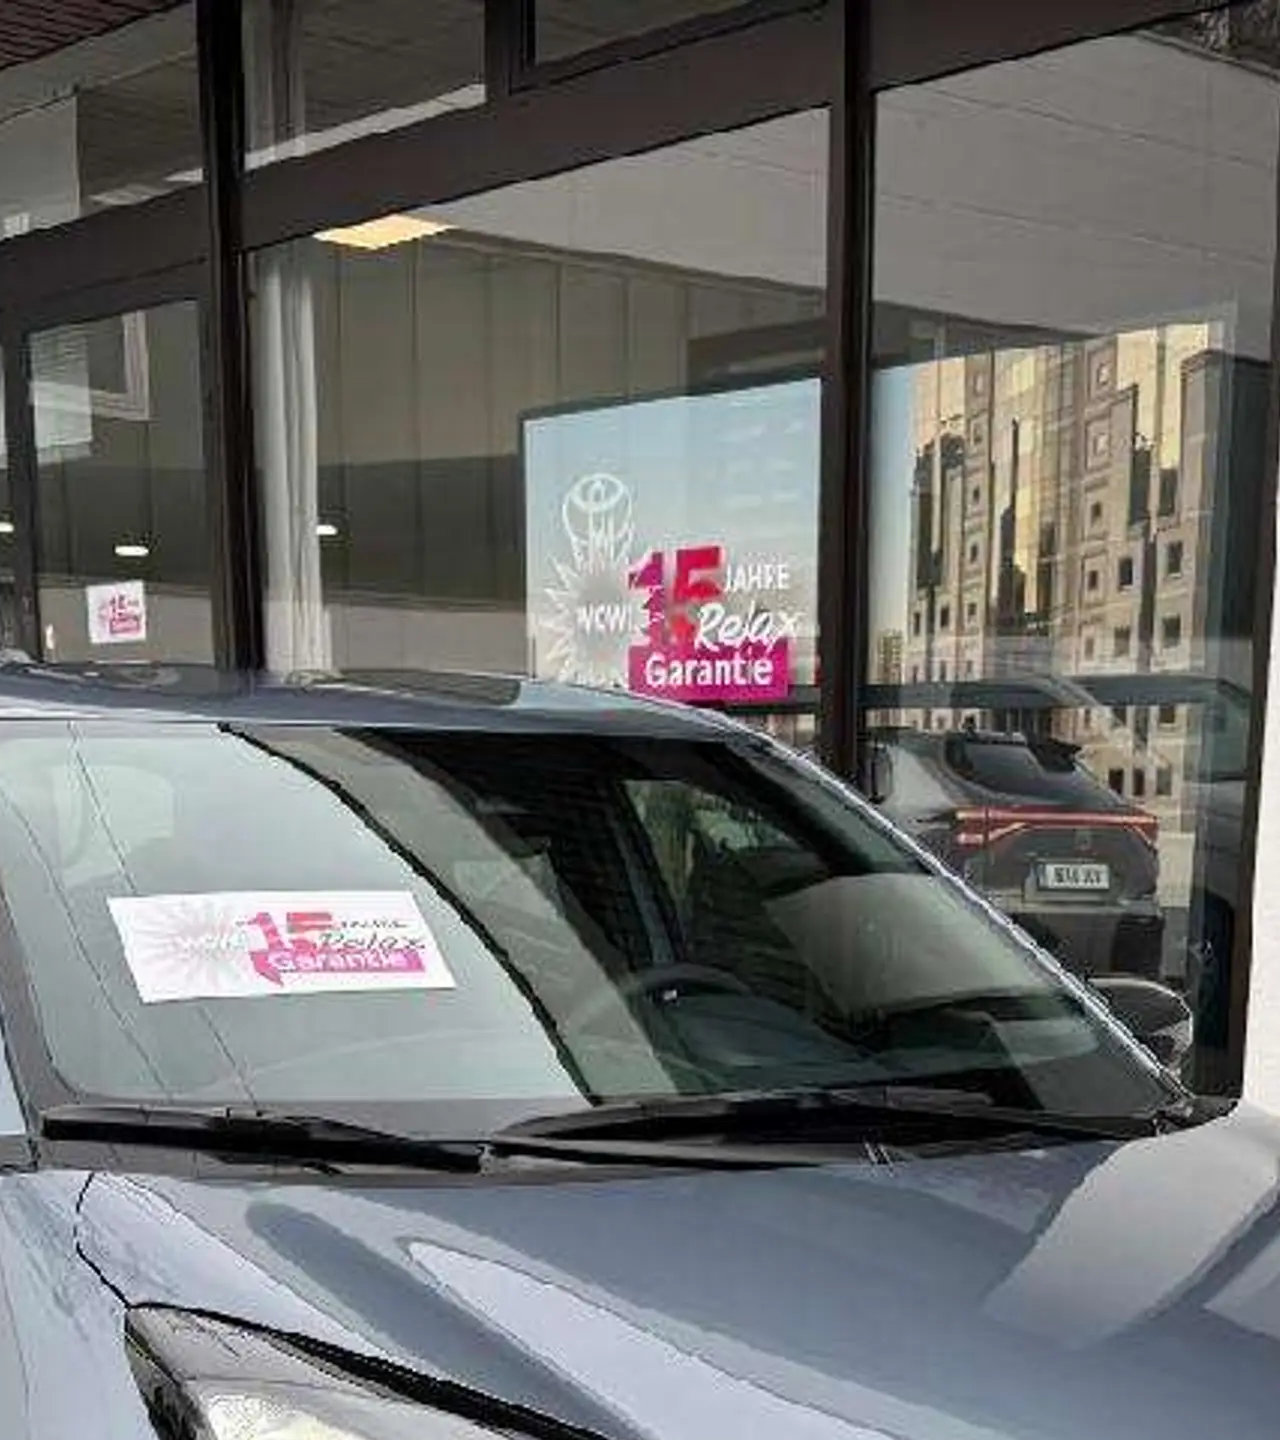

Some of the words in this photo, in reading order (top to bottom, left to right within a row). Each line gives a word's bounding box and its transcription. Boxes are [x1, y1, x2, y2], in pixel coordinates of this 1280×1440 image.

[724, 563, 791, 592] JAHRE
[693, 600, 803, 652] Relax
[644, 652, 774, 687] Garantie
